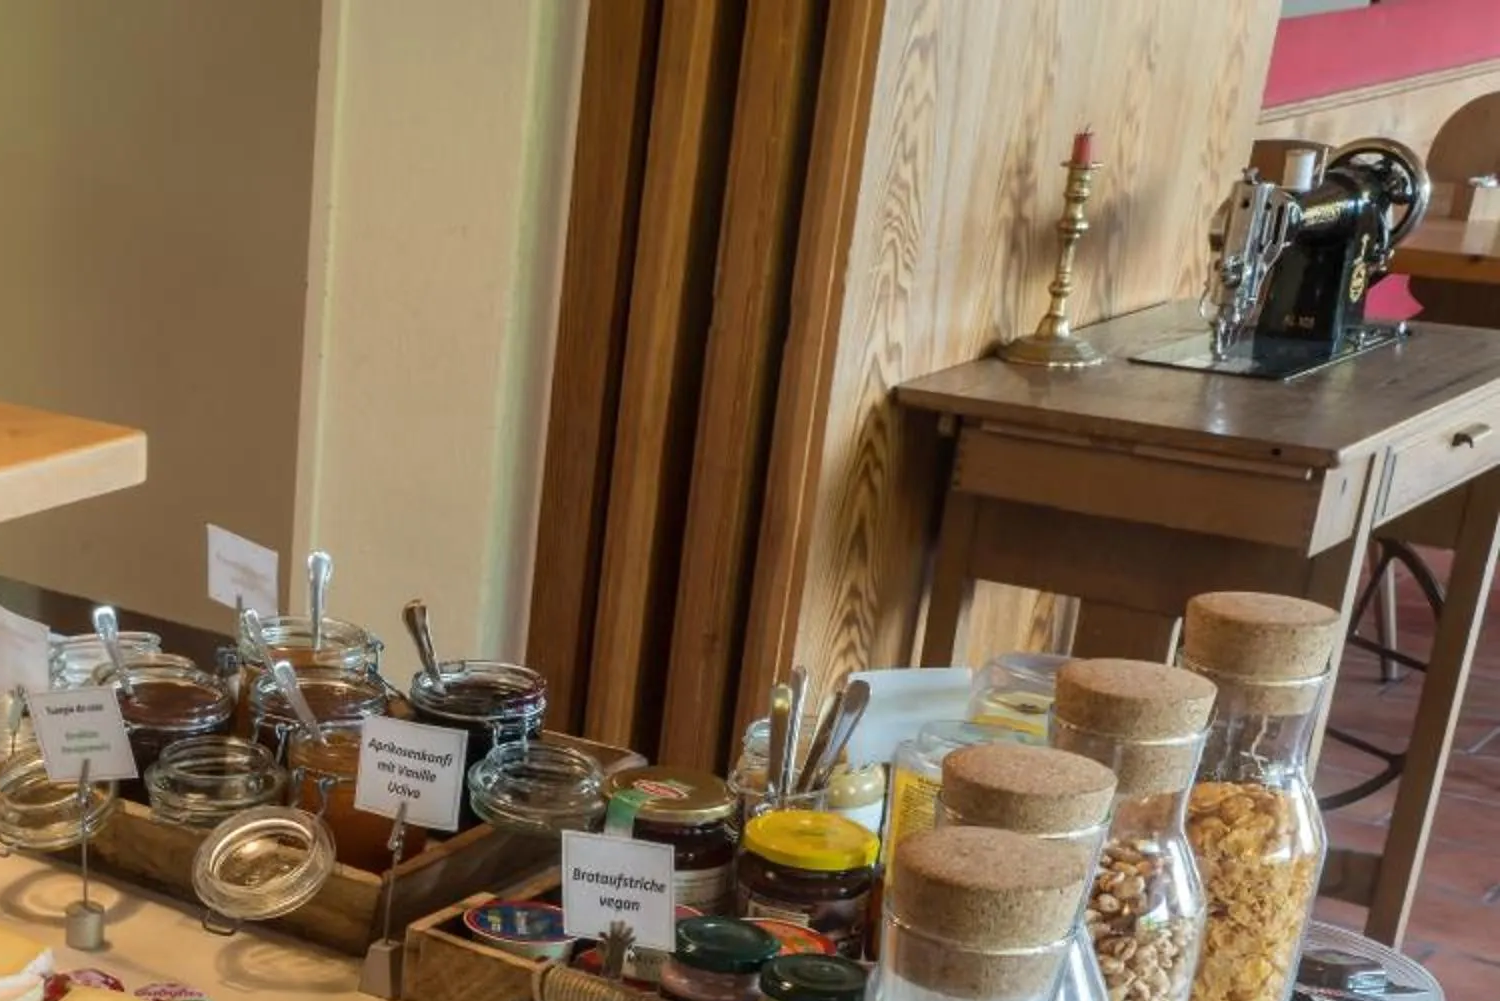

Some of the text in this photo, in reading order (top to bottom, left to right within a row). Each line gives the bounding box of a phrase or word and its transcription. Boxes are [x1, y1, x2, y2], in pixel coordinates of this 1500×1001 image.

[368, 738, 453, 767] Aprikosenkonfi
[377, 760, 437, 783] mit Vanille
[572, 867, 667, 893] Brotaufstriche
[599, 895, 641, 911] vegan
